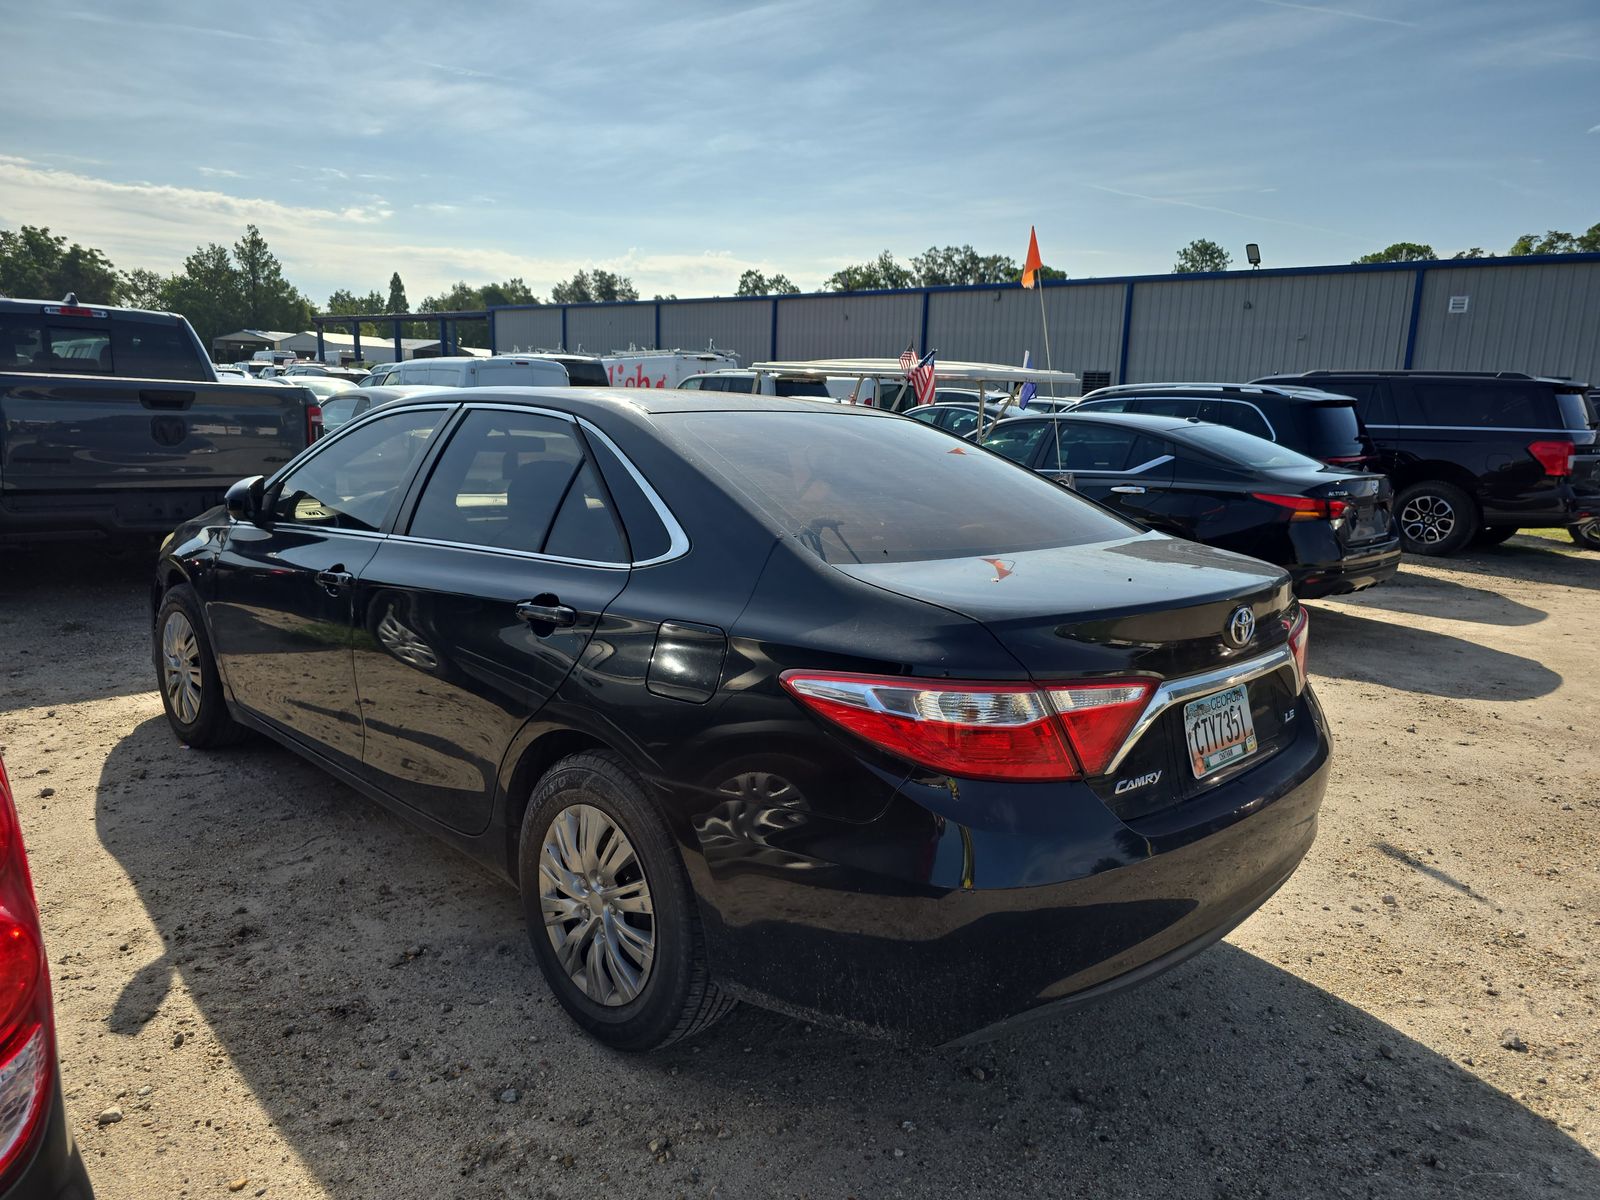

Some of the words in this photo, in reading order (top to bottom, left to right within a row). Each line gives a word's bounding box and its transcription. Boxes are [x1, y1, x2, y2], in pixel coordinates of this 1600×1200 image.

[1211, 688, 1244, 710] GEORGIA
[1285, 709, 1295, 722] LE
[1115, 770, 1162, 794] CAMRY
